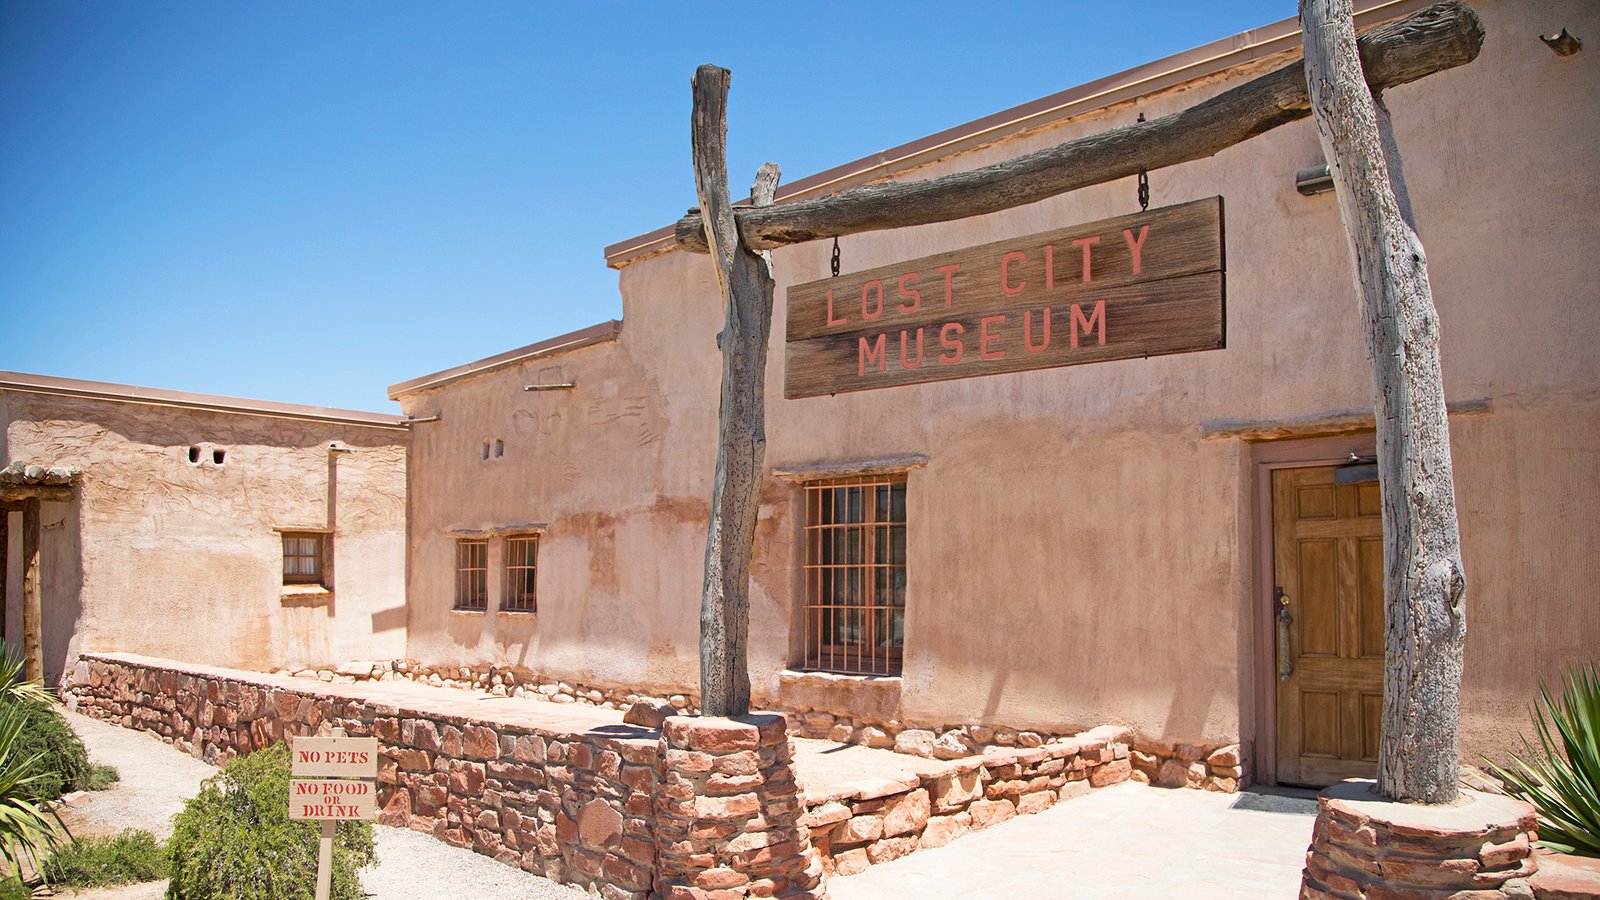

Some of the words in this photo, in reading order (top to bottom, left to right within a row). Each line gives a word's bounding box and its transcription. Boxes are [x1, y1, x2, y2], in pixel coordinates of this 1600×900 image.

[826, 263, 962, 327] LOST
[1000, 224, 1150, 296] CITY
[857, 299, 1107, 377] MUSEUM
[299, 751, 321, 763] NO
[325, 751, 369, 764] PETS
[296, 783, 319, 795] NO
[322, 783, 368, 795] FOOD
[324, 796, 341, 804] OR
[303, 804, 360, 817] DRINK
